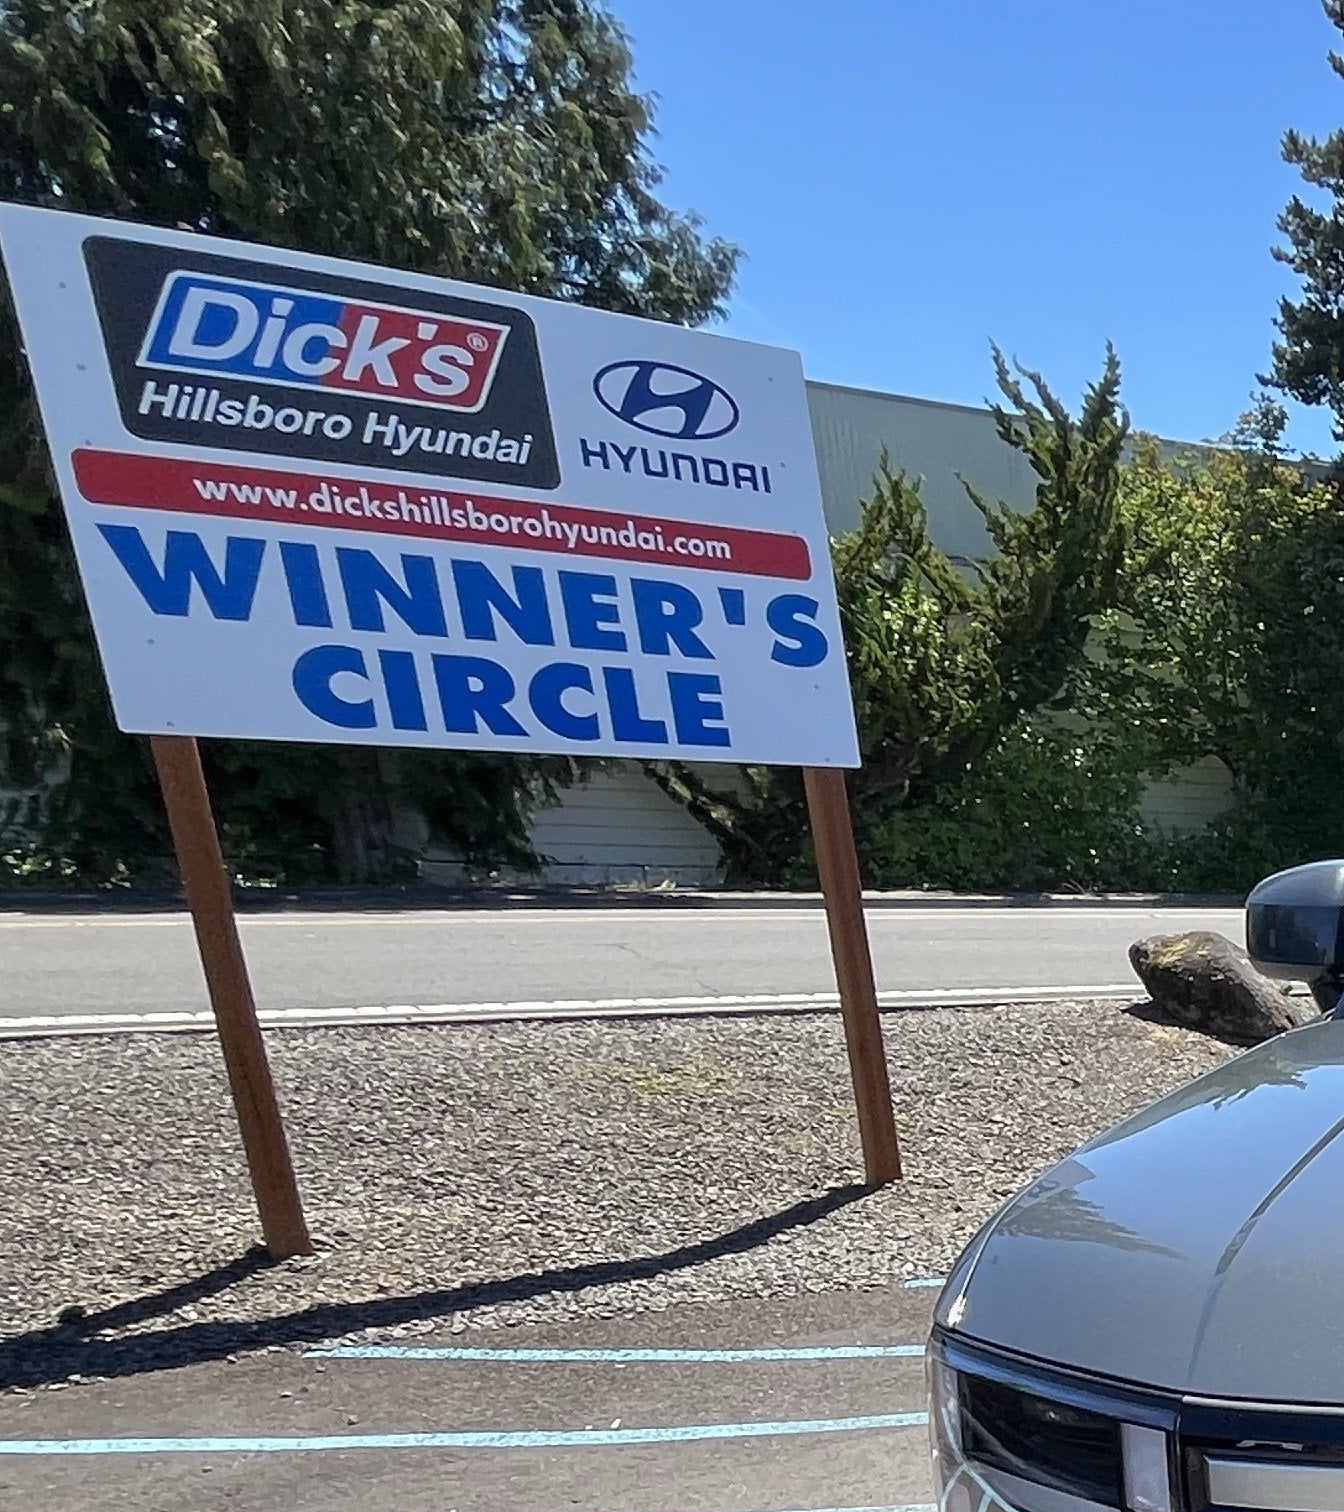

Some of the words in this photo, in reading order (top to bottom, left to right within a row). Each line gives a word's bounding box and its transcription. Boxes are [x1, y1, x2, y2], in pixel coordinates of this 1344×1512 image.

[169, 285, 475, 397] Dick's
[138, 380, 352, 440] Hillsboro
[362, 411, 533, 465] Hyundai
[579, 438, 772, 494] HYUNDAI
[193, 475, 732, 561] www.dickshillsborohyundai.com
[96, 523, 829, 668] WINNER'S
[292, 643, 732, 747] CIRCLE
